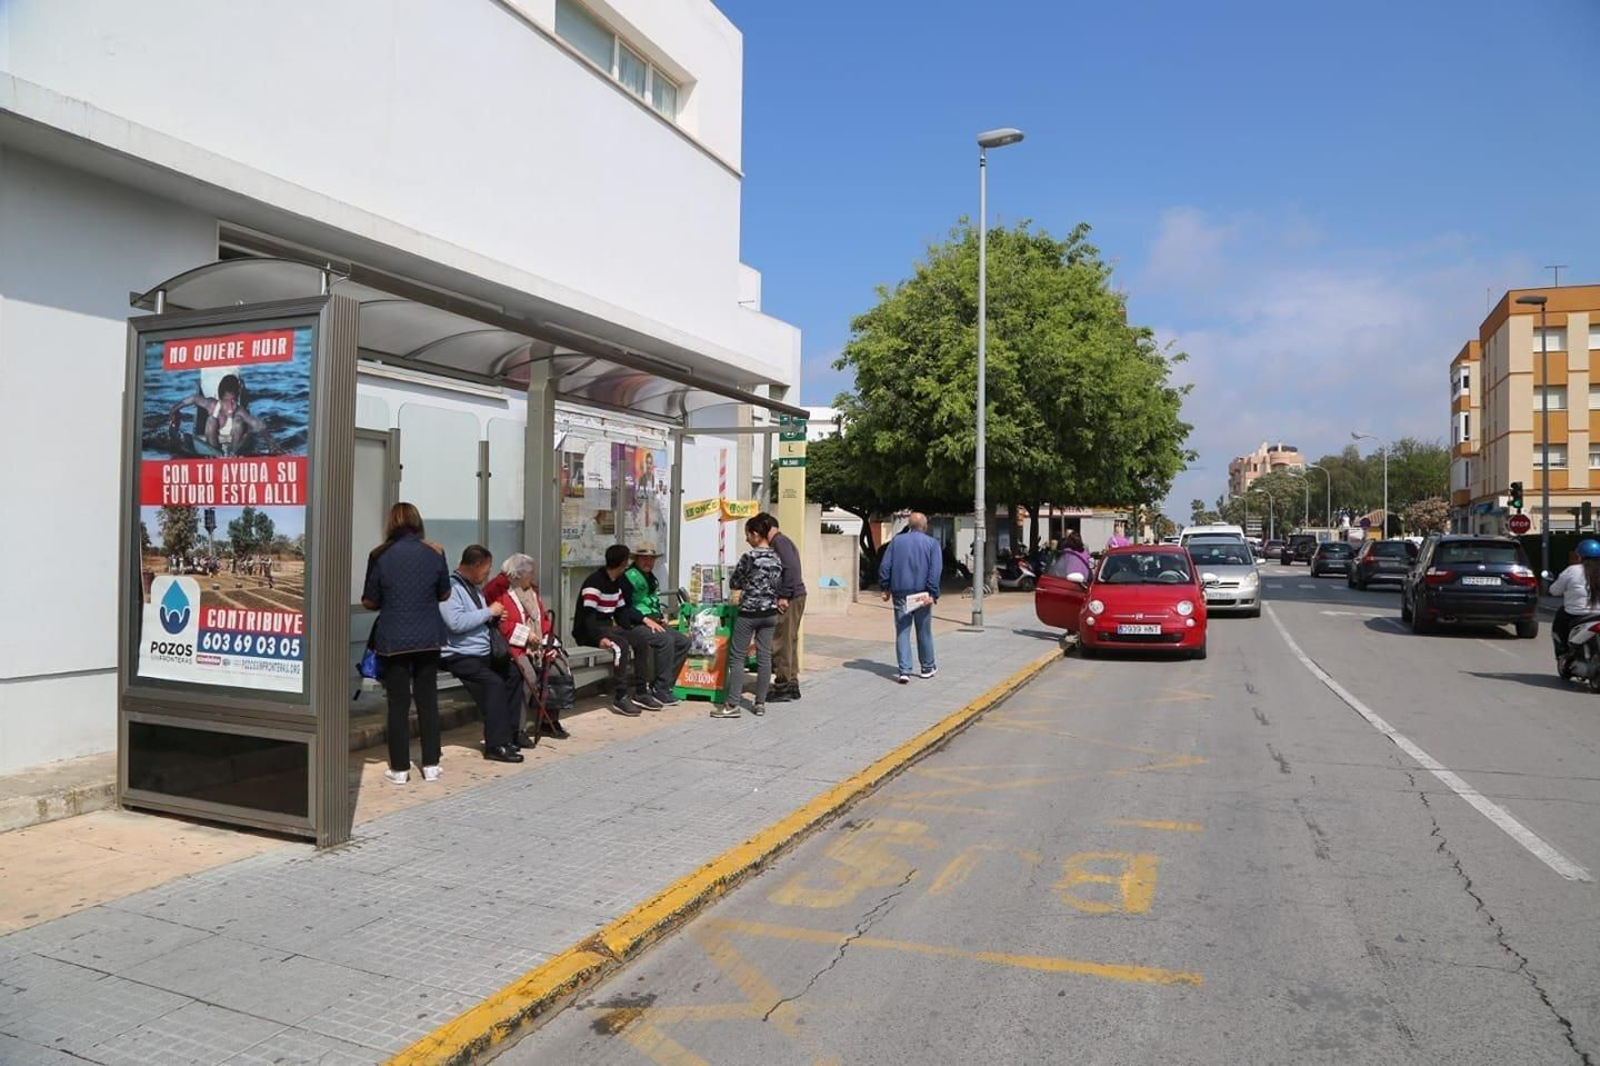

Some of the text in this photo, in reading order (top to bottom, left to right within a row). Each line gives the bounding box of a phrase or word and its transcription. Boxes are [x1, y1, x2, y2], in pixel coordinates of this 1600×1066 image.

[169, 337, 288, 364] NO QUIERE HUIR
[163, 461, 297, 484] CON TU AYUDA SU
[163, 483, 297, 504] FUTURO ESTA ALLI
[207, 608, 303, 634] CONTRIBUYE
[150, 641, 193, 657] POZOS
[202, 632, 300, 657] 603 69 03 05
